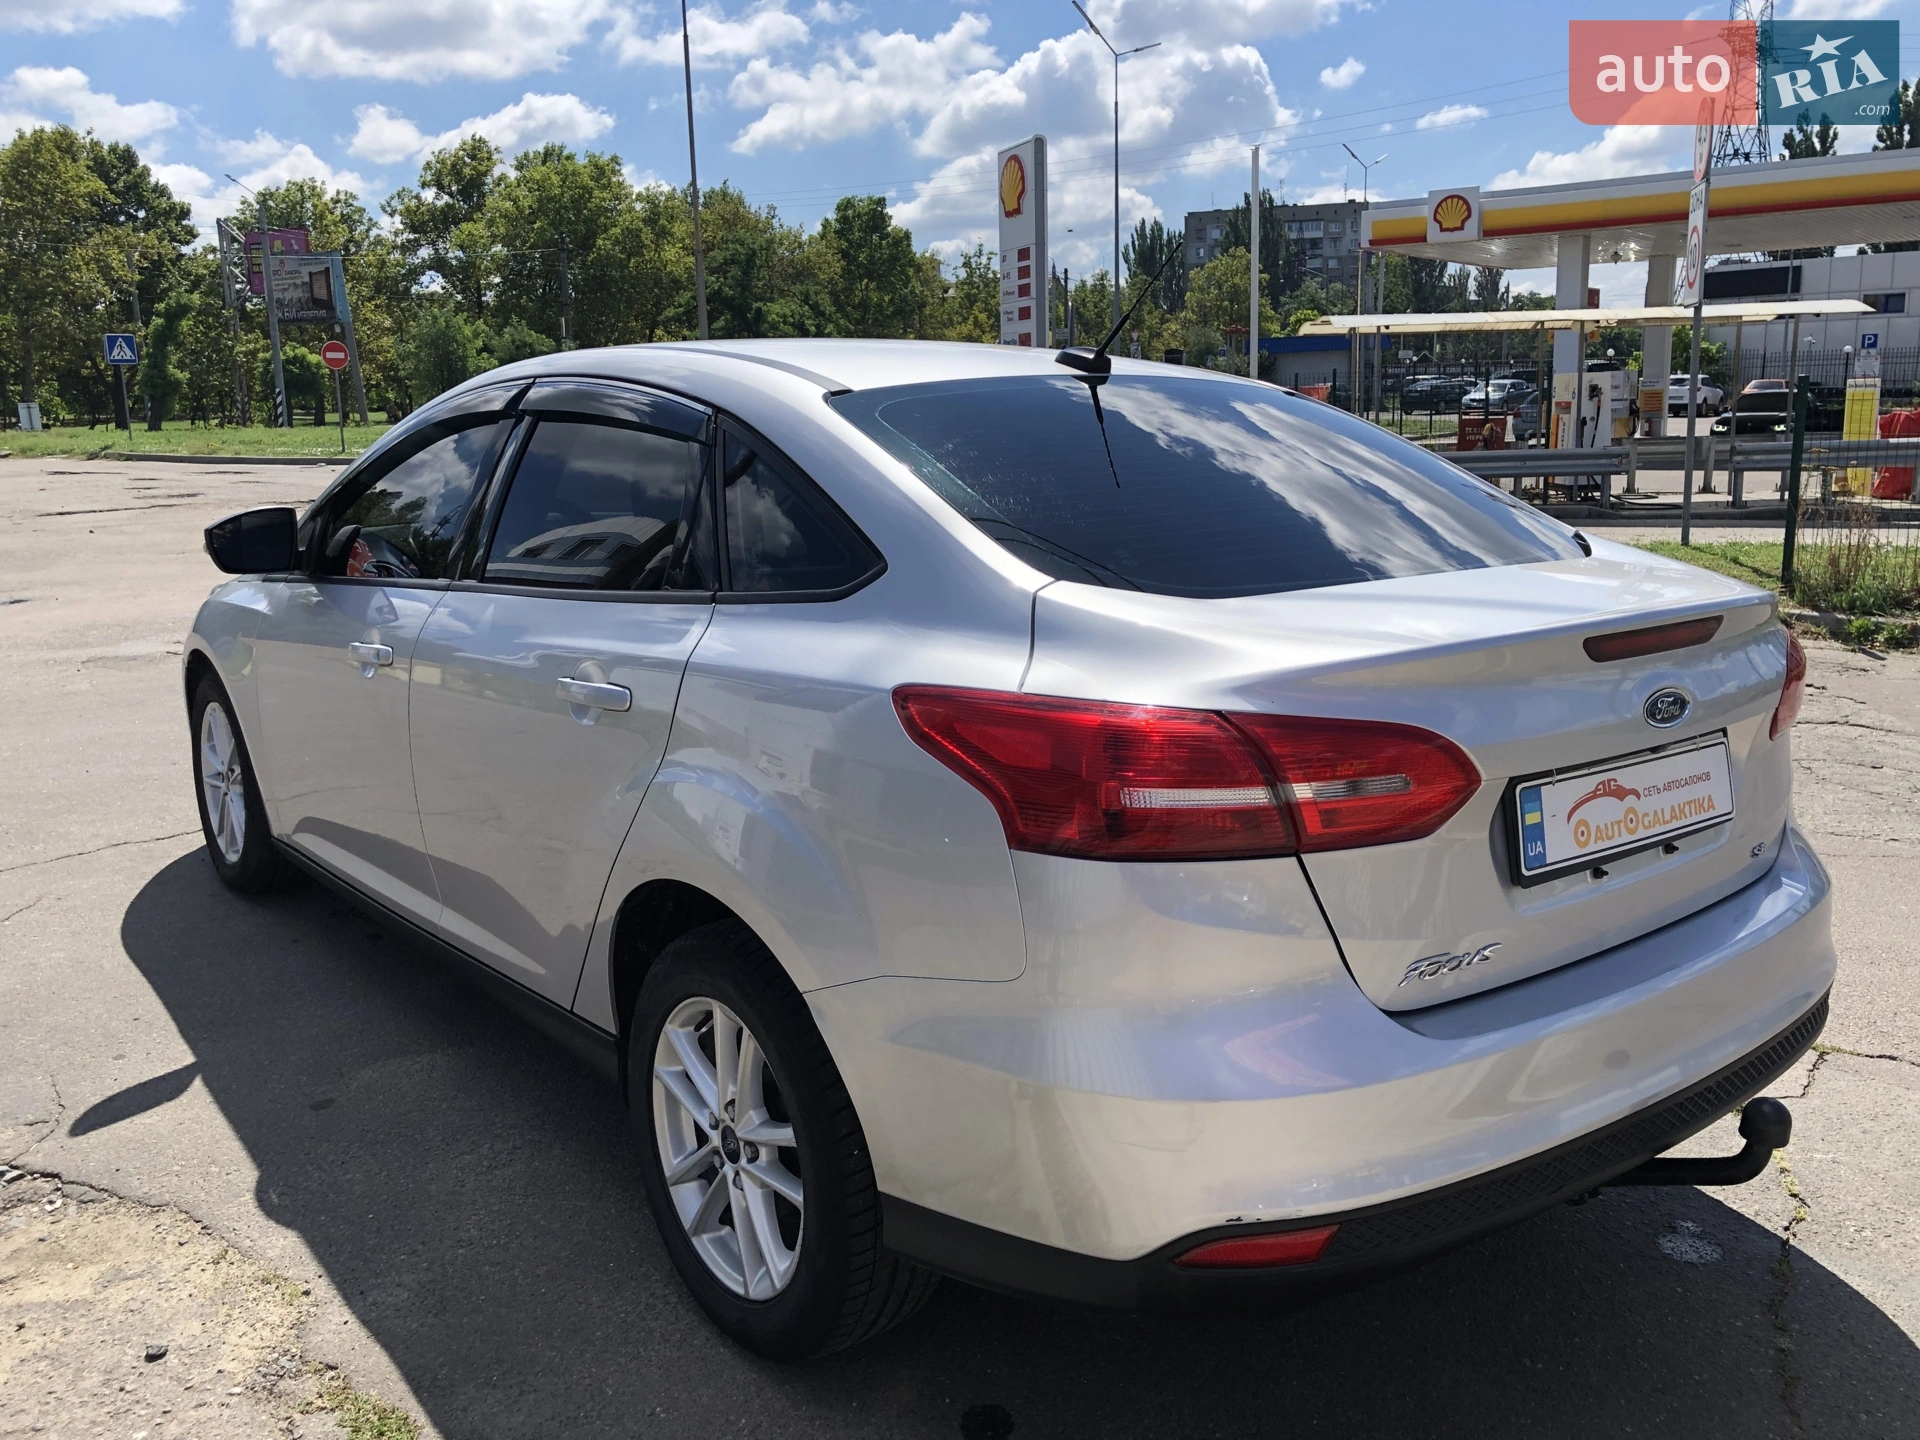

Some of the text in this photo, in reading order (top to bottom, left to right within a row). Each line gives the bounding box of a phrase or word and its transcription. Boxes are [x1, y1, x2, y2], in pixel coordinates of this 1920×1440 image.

[1689, 243, 1697, 271] 10
[1865, 334, 1875, 348] P
[1655, 696, 1681, 720] Ford
[1643, 771, 1711, 798] СЕТЬ АВТОСАЛОНОВ
[1528, 844, 1544, 856] UA
[1398, 942, 1502, 987] Focus
